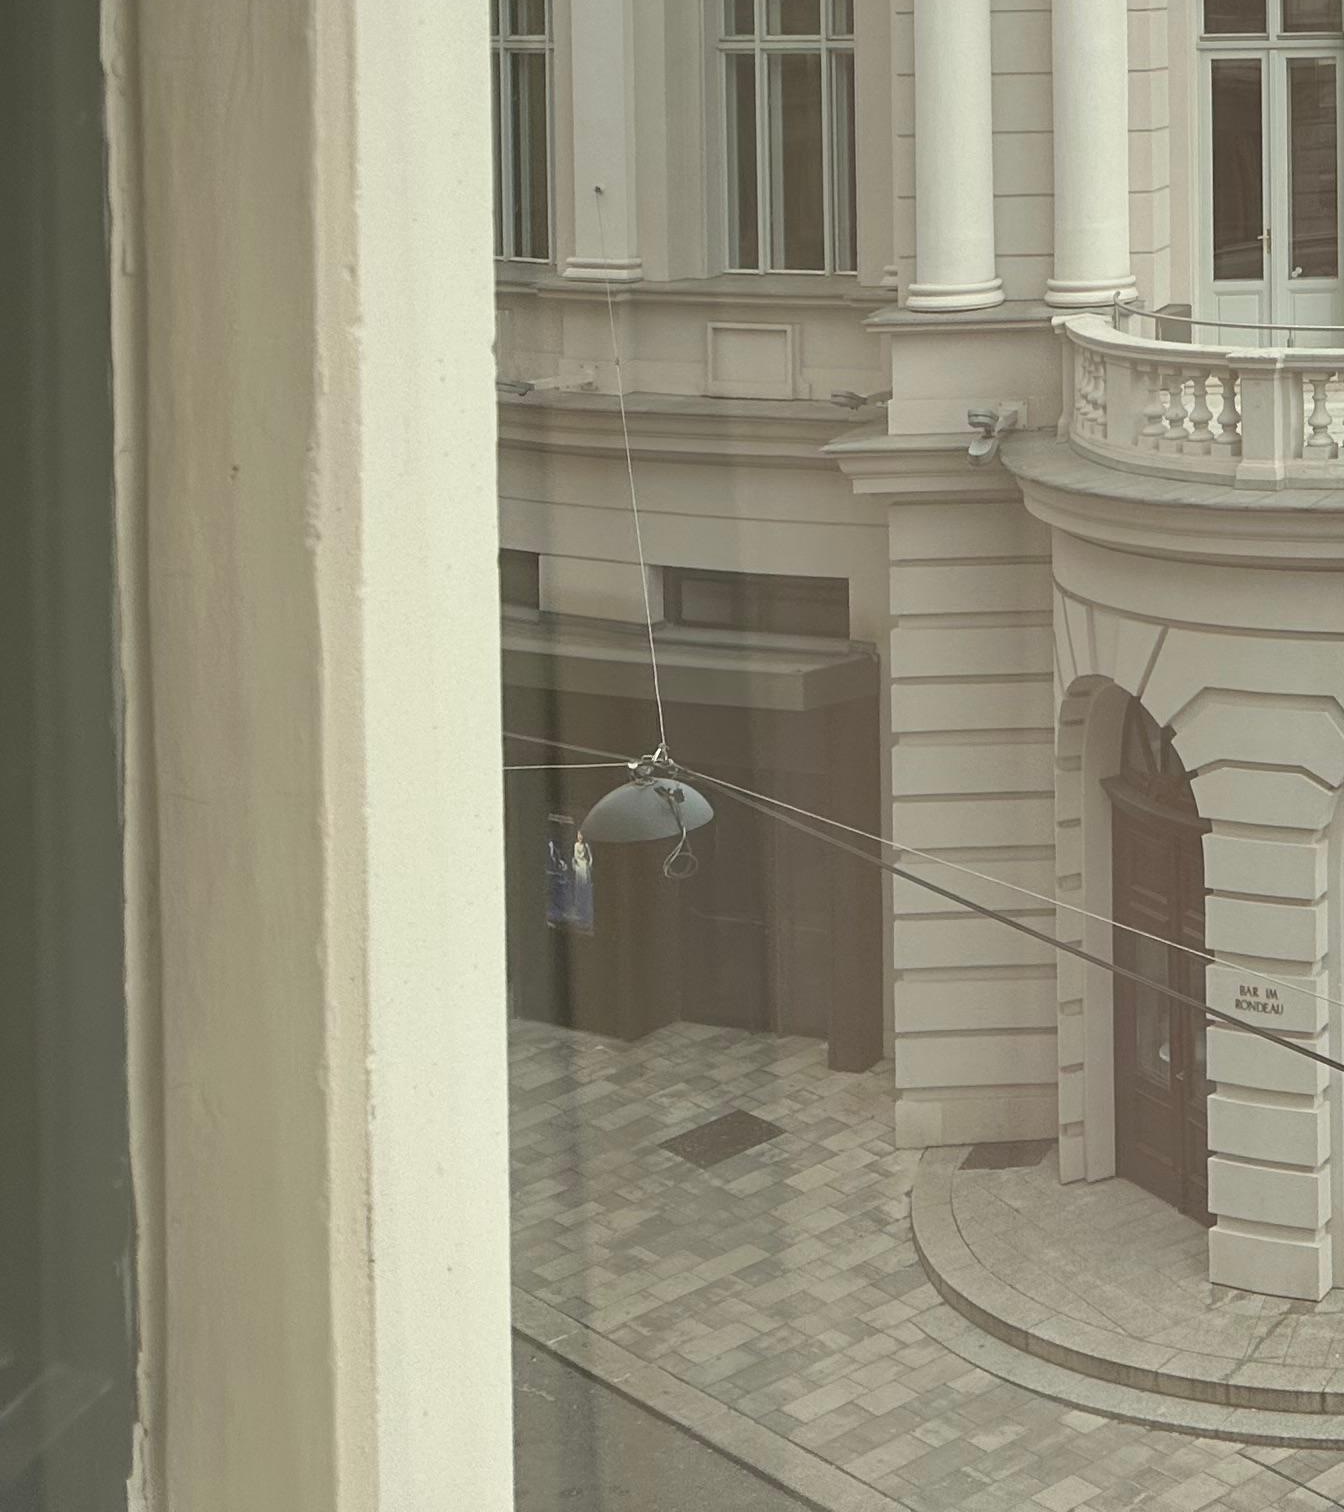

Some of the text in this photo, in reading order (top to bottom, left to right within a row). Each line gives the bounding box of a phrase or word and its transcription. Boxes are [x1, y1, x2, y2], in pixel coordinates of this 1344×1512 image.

[1240, 985, 1279, 1000] BAR IM
[1235, 999, 1284, 1016] RONDEAU
